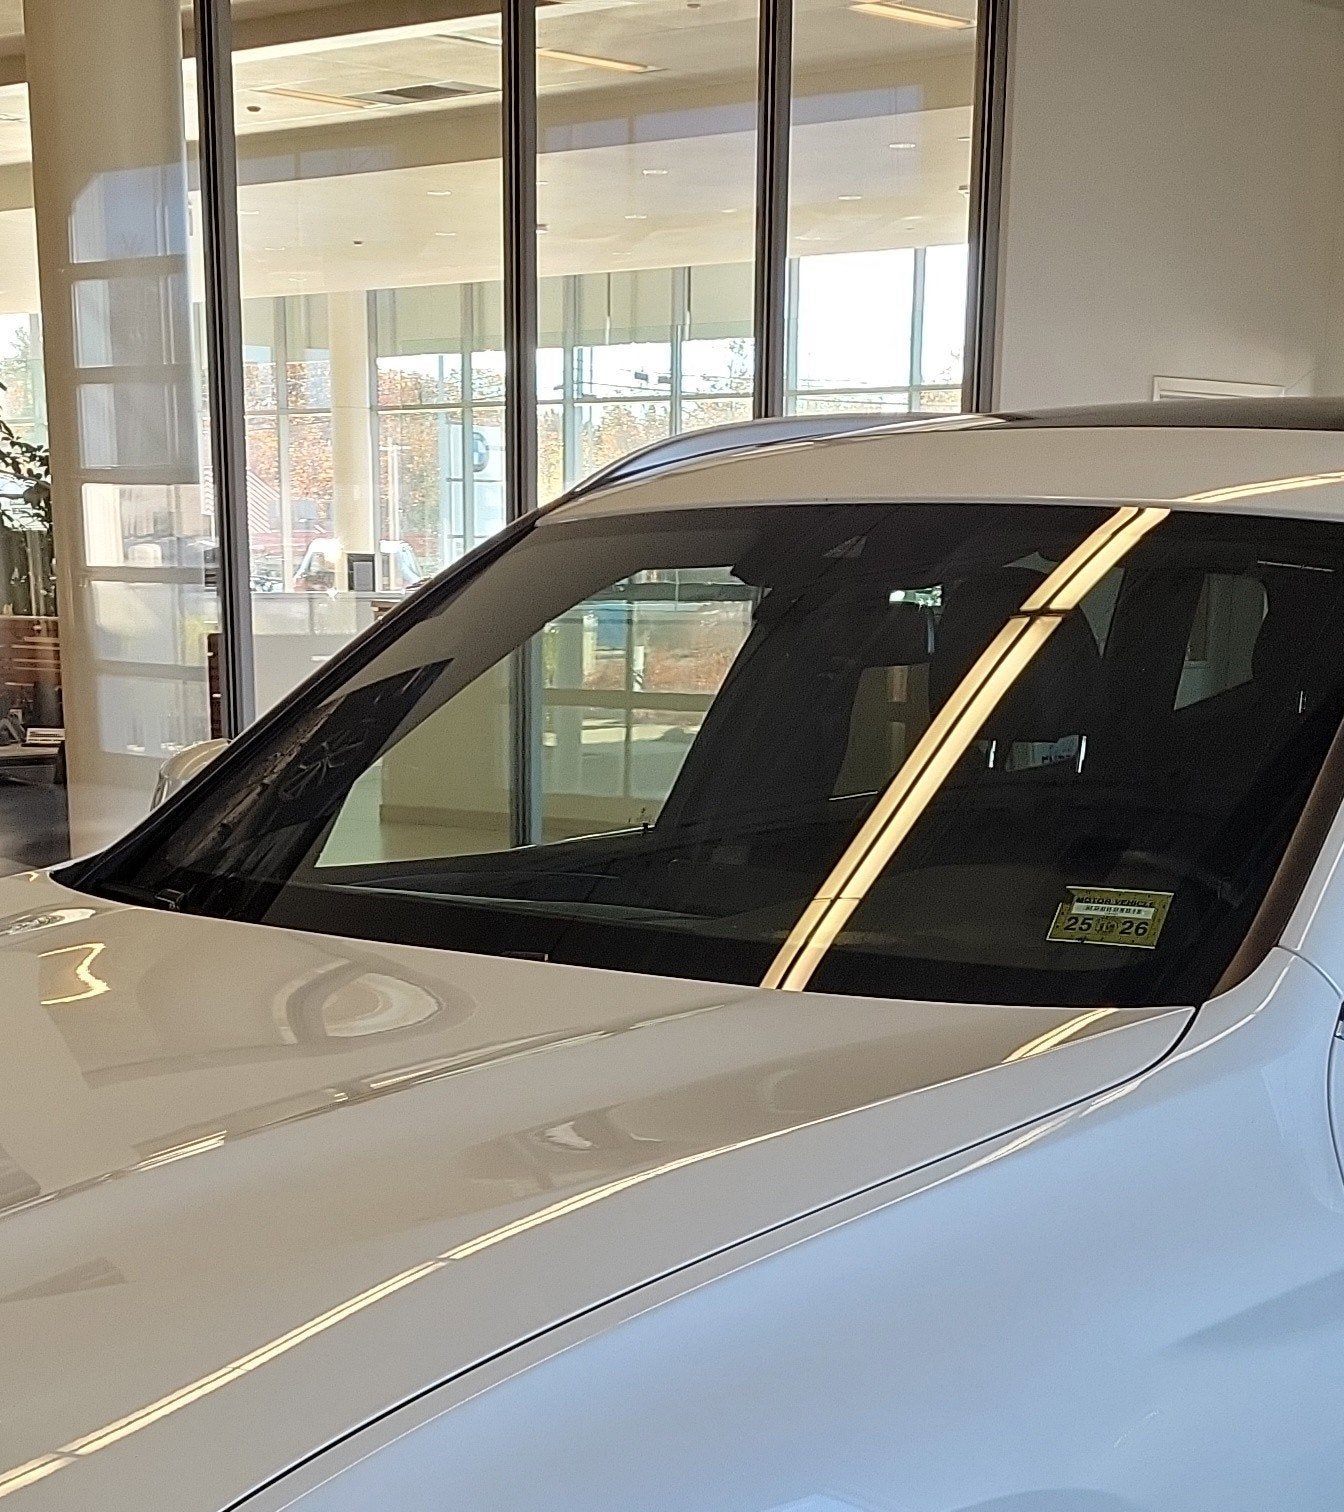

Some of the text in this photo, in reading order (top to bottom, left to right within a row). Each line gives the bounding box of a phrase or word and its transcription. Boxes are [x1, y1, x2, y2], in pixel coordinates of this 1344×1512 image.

[1075, 896, 1112, 905] MOTOR
[1063, 916, 1094, 932] 25
[1119, 920, 1149, 936] 26
